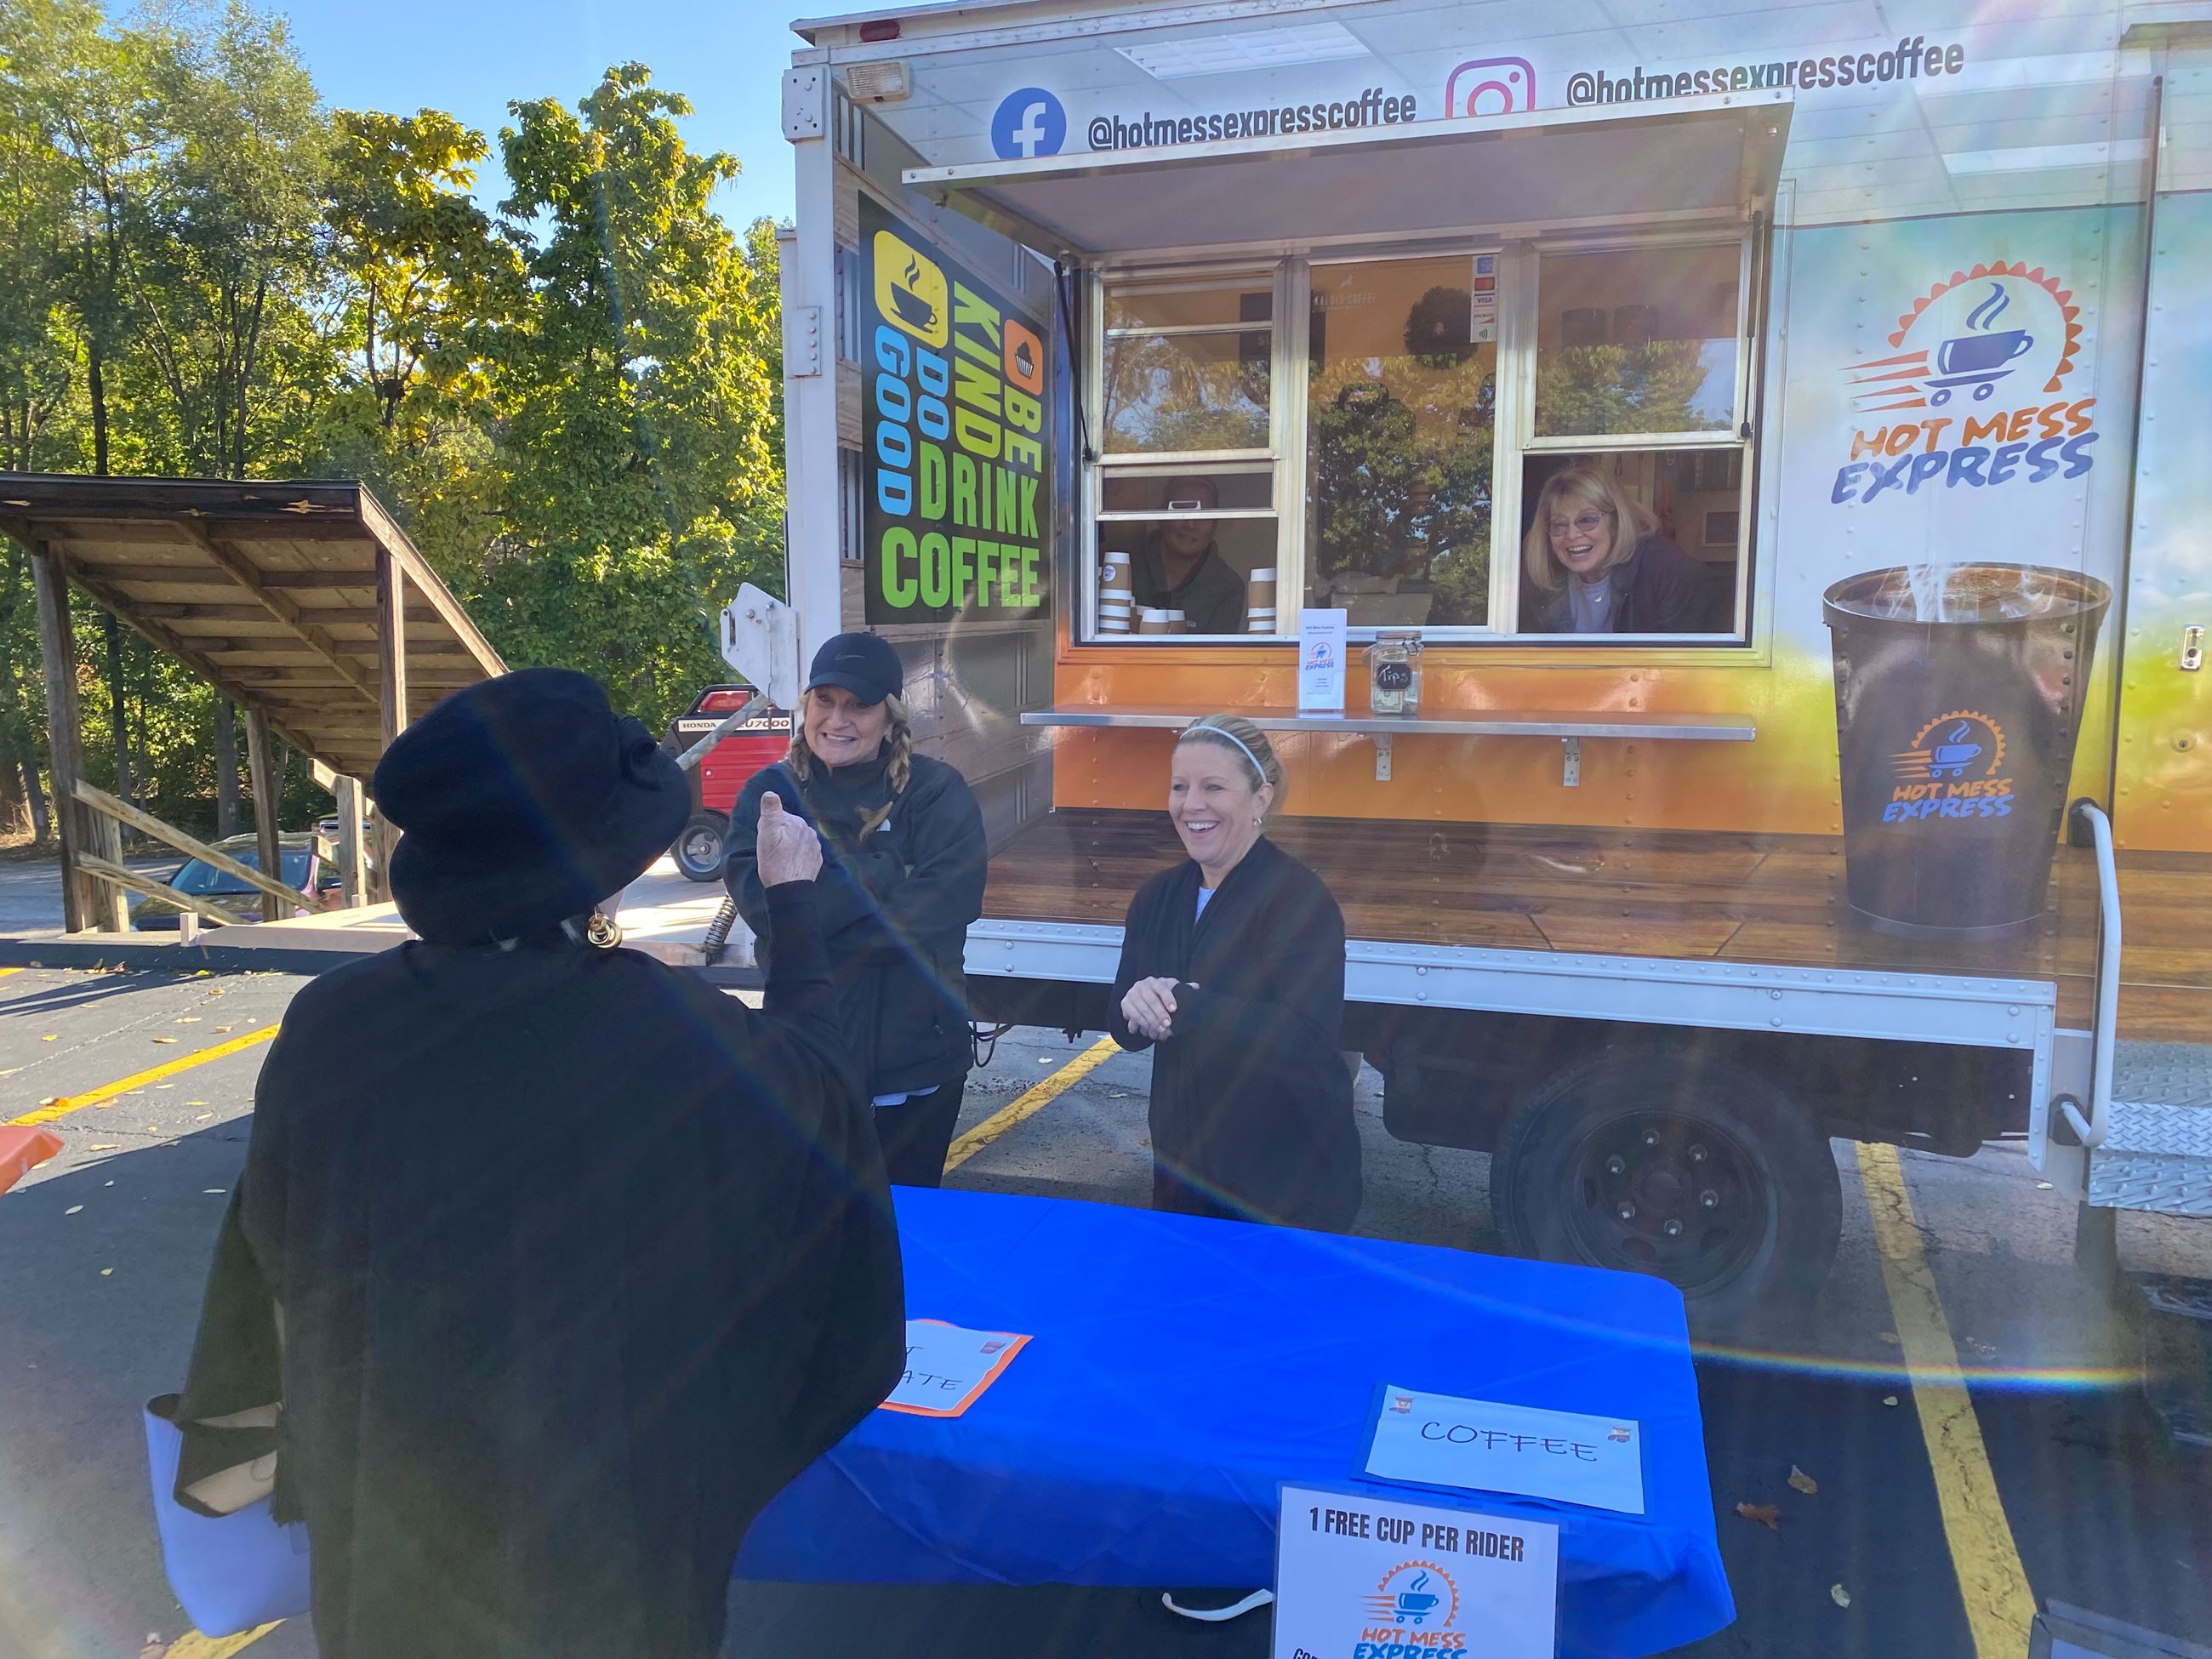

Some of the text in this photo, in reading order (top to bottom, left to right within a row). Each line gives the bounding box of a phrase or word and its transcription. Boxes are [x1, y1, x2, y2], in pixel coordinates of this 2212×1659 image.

[1088, 88, 1417, 151] @hotmessexpresscoffee
[916, 346, 949, 441] DO
[954, 281, 1001, 459] KIND
[875, 325, 912, 516] GOOD
[1004, 388, 1043, 473] BE
[1850, 398, 2097, 461] HOT MESS
[920, 440, 1040, 539] DRINK
[1831, 432, 2100, 505] EXPRESS
[881, 527, 1040, 608] COFFEE
[1883, 794, 2015, 823] EXPRESS
[1893, 778, 2014, 801] HOT MESS
[1421, 1422, 1598, 1462] COFFEE
[1310, 1507, 1525, 1562] 1 FREE CUP PER RIDER
[1361, 1627, 1467, 1649] HOT MESS
